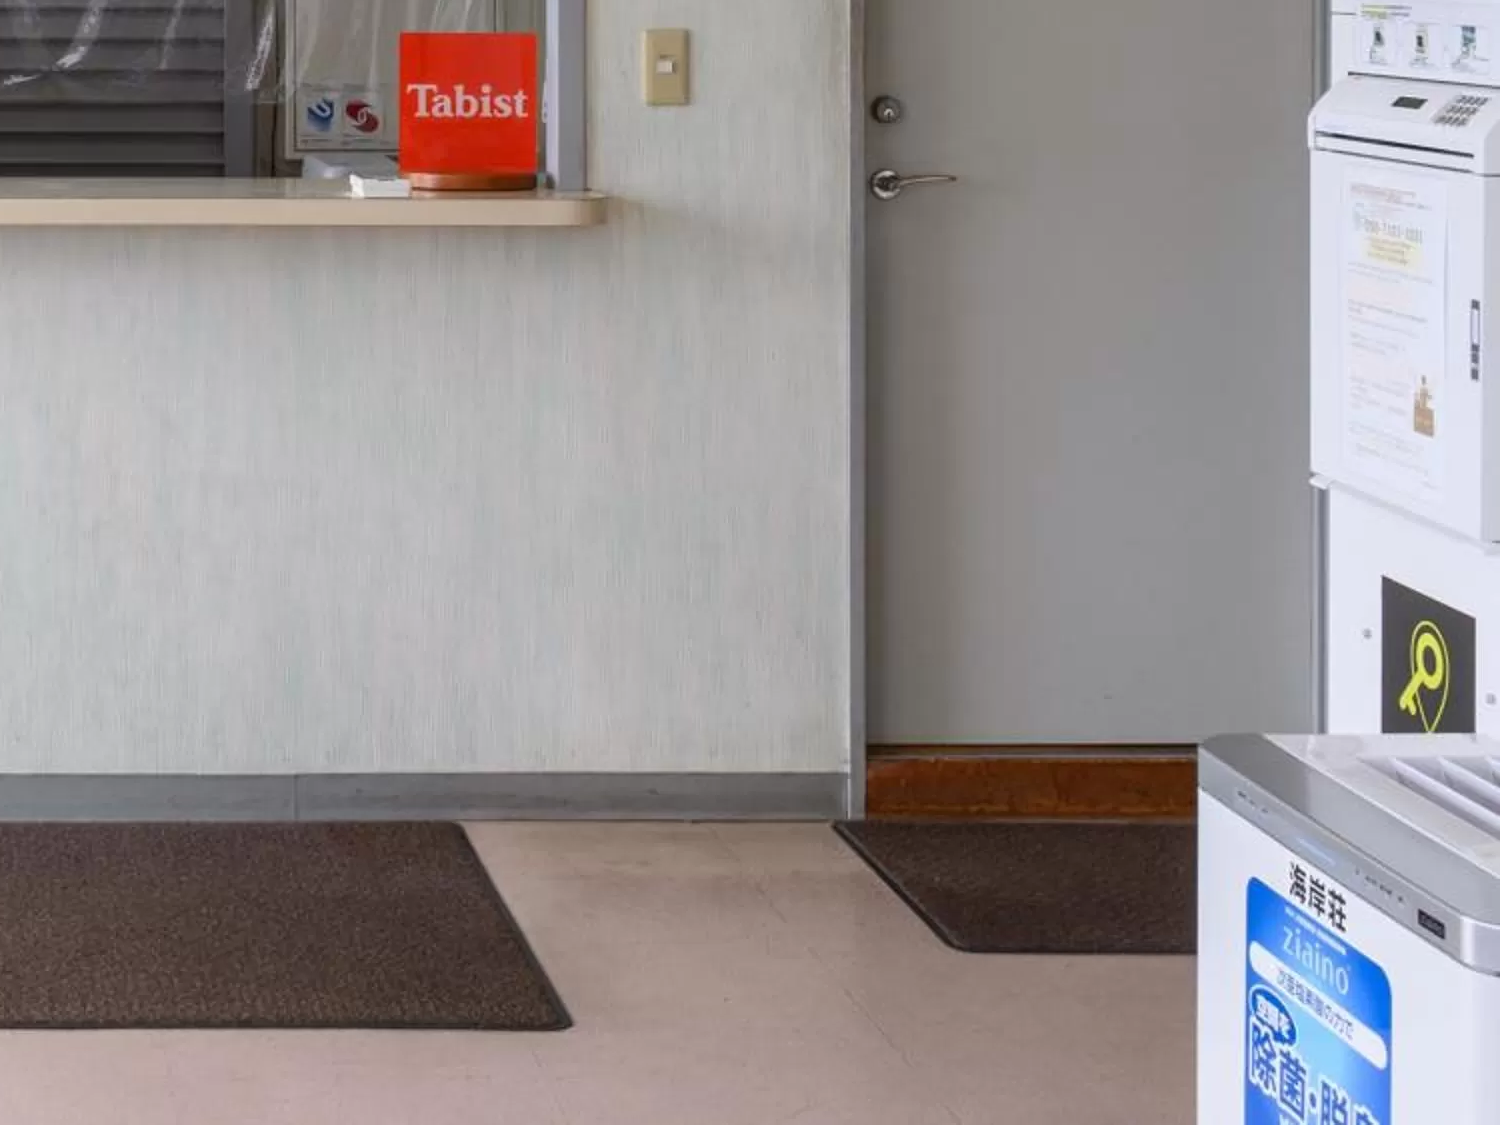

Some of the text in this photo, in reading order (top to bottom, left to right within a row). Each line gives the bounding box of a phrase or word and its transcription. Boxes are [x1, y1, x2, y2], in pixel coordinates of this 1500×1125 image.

[407, 83, 528, 119] Tabist
[1289, 862, 1348, 932] 海岸荘
[1282, 925, 1350, 996] ziaino
[1251, 1021, 1372, 1125] 除菌・脱
